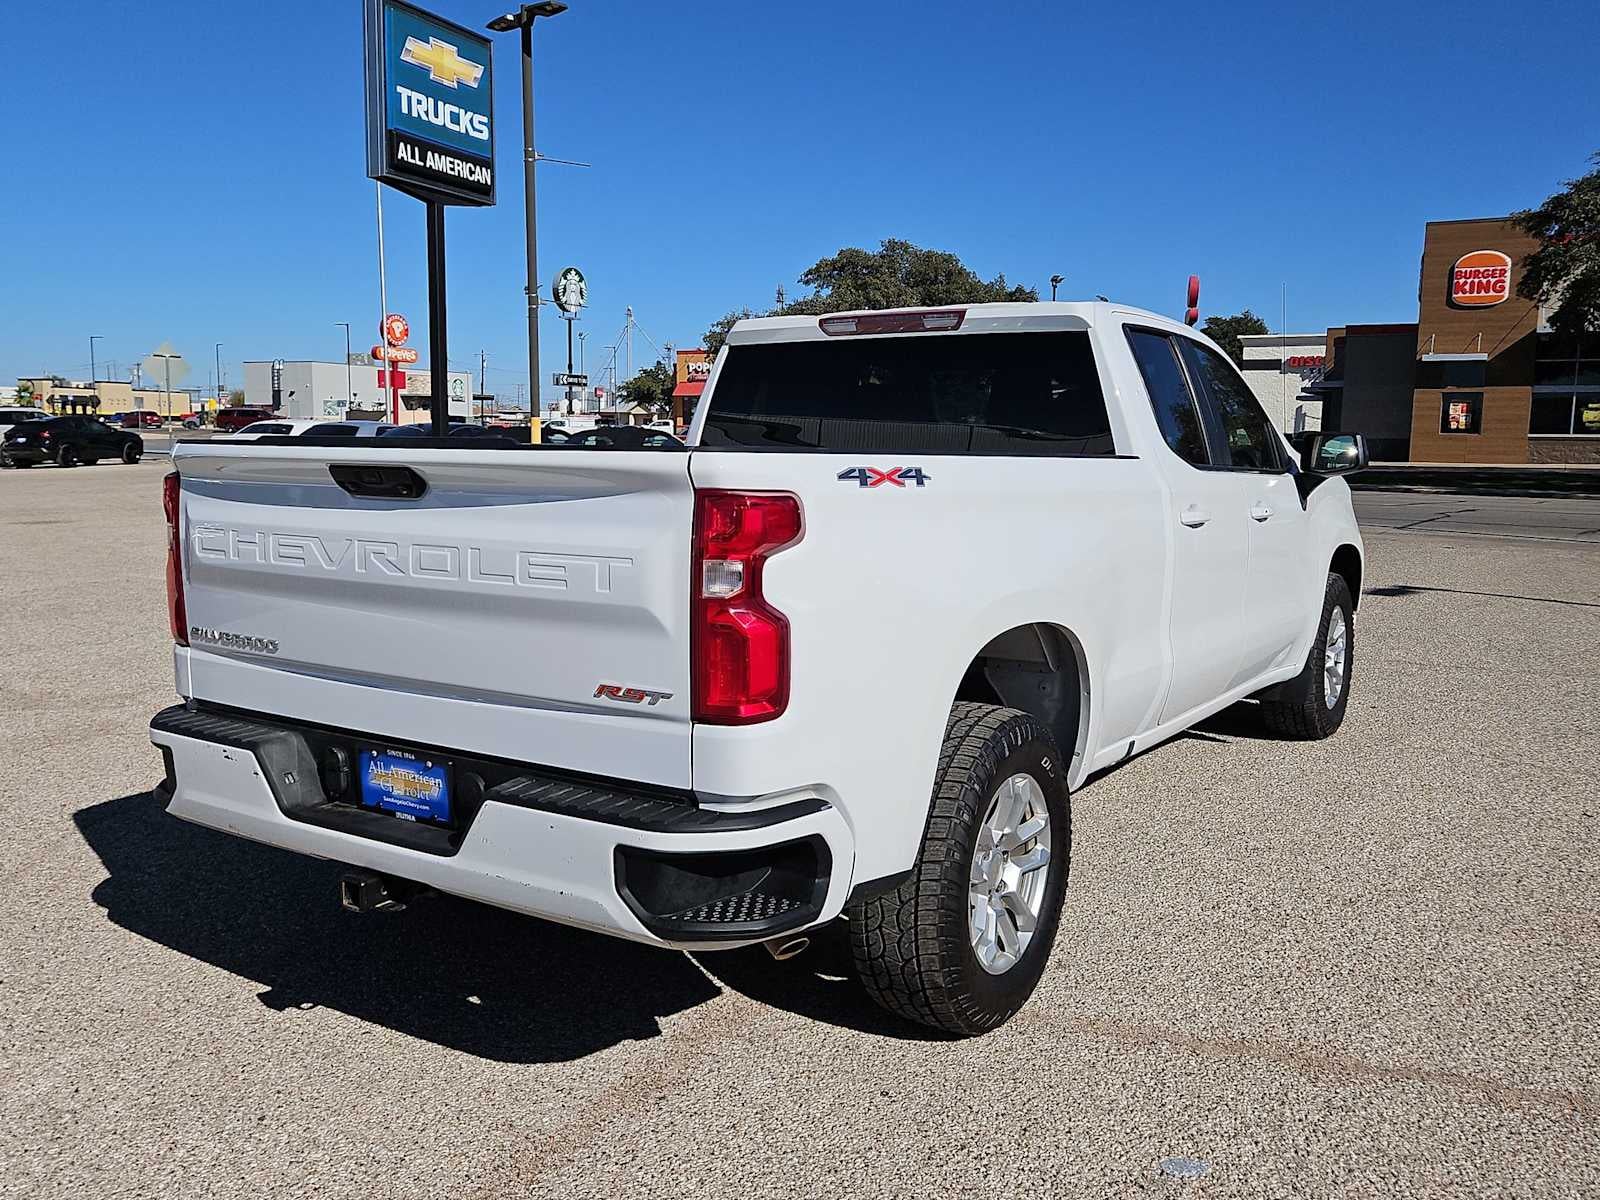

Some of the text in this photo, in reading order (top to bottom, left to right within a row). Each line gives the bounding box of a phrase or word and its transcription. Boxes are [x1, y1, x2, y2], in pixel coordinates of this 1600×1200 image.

[396, 85, 489, 140] TRUCKS
[397, 141, 491, 185] ALL AMERICAN
[1455, 268, 1507, 280] BURGER
[1454, 279, 1506, 295] KING
[688, 361, 713, 372] POP
[193, 526, 634, 593] CHEVROLET
[190, 626, 279, 654] SILVERADO
[593, 684, 674, 706] RST
[368, 760, 443, 788] All American
[380, 778, 431, 801] Chrolet
